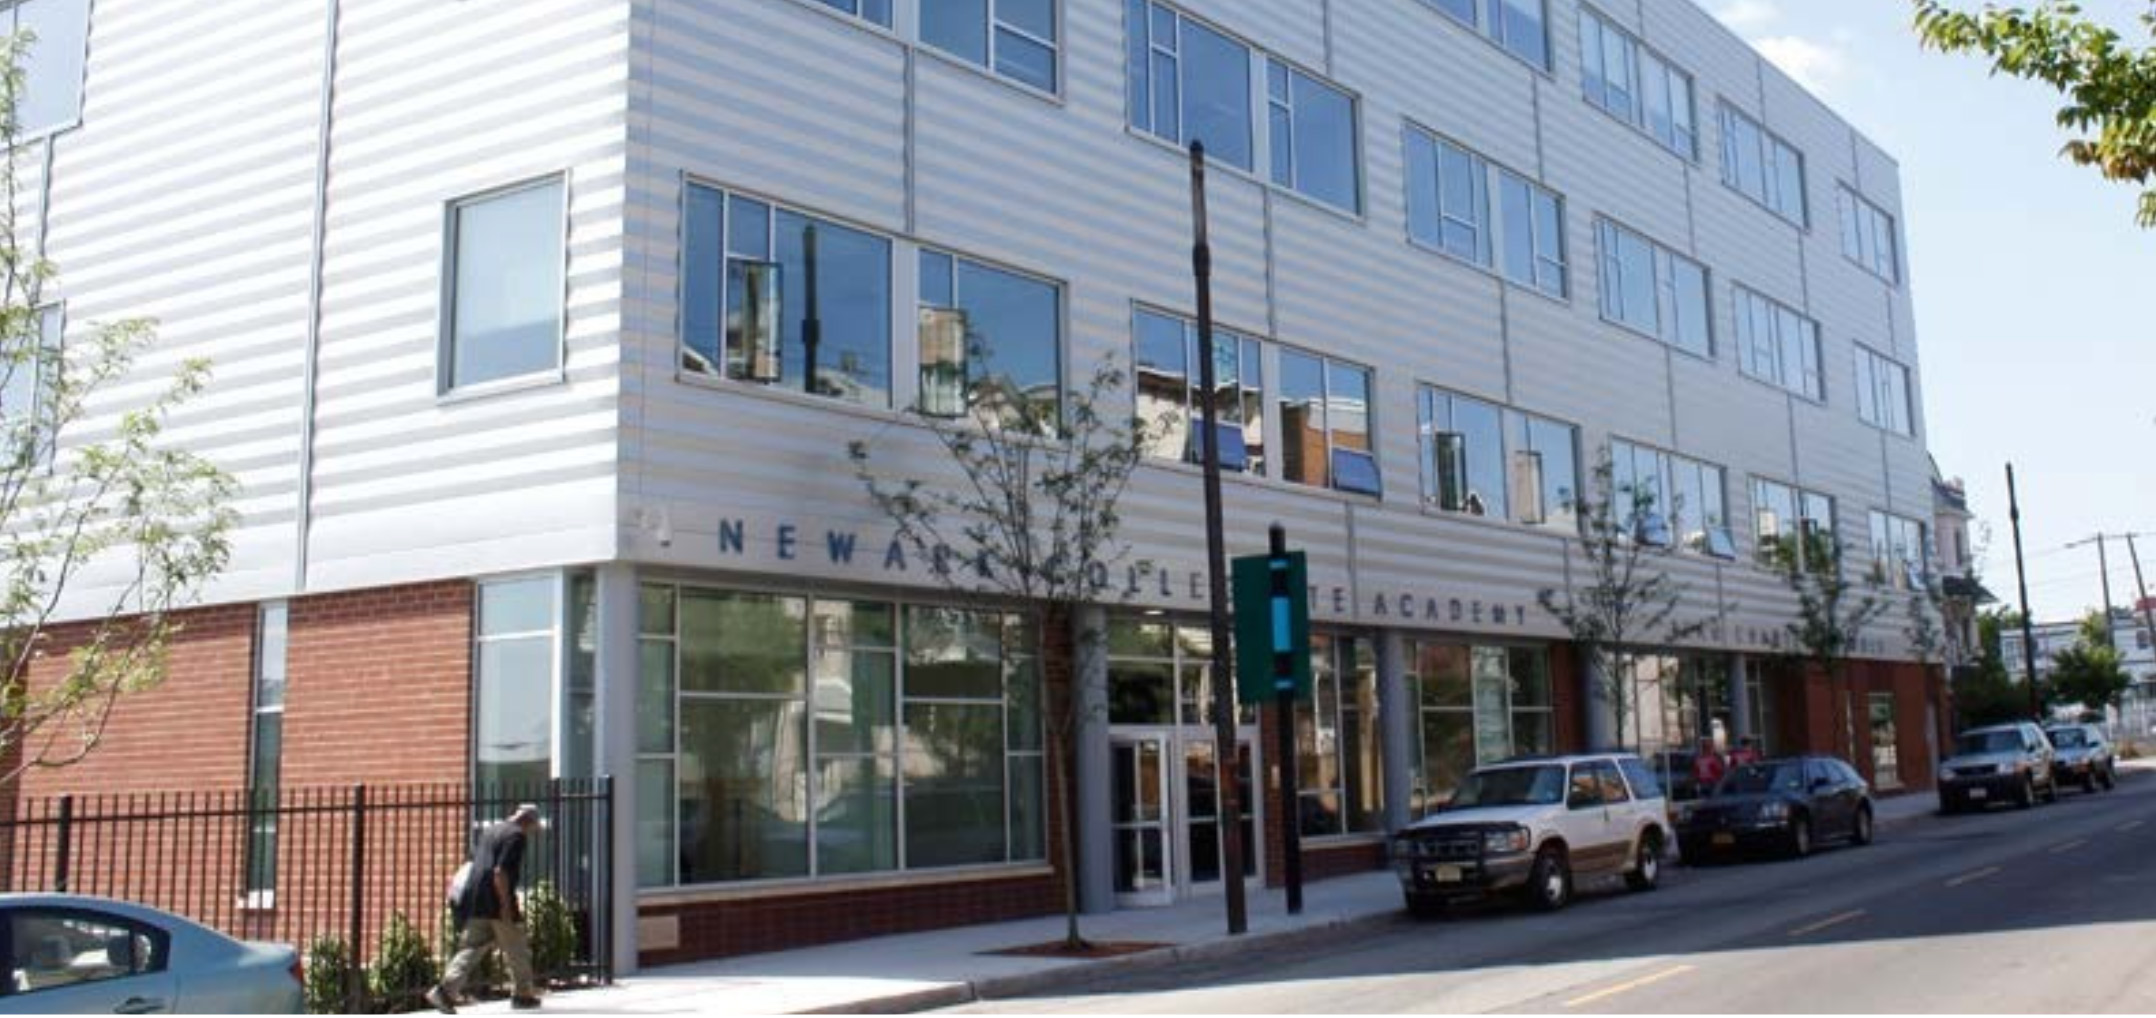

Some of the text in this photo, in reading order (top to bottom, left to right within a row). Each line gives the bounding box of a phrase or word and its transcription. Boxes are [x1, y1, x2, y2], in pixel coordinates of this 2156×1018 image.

[719, 518, 1525, 626] NEWARK COLLETE ACADEMY
